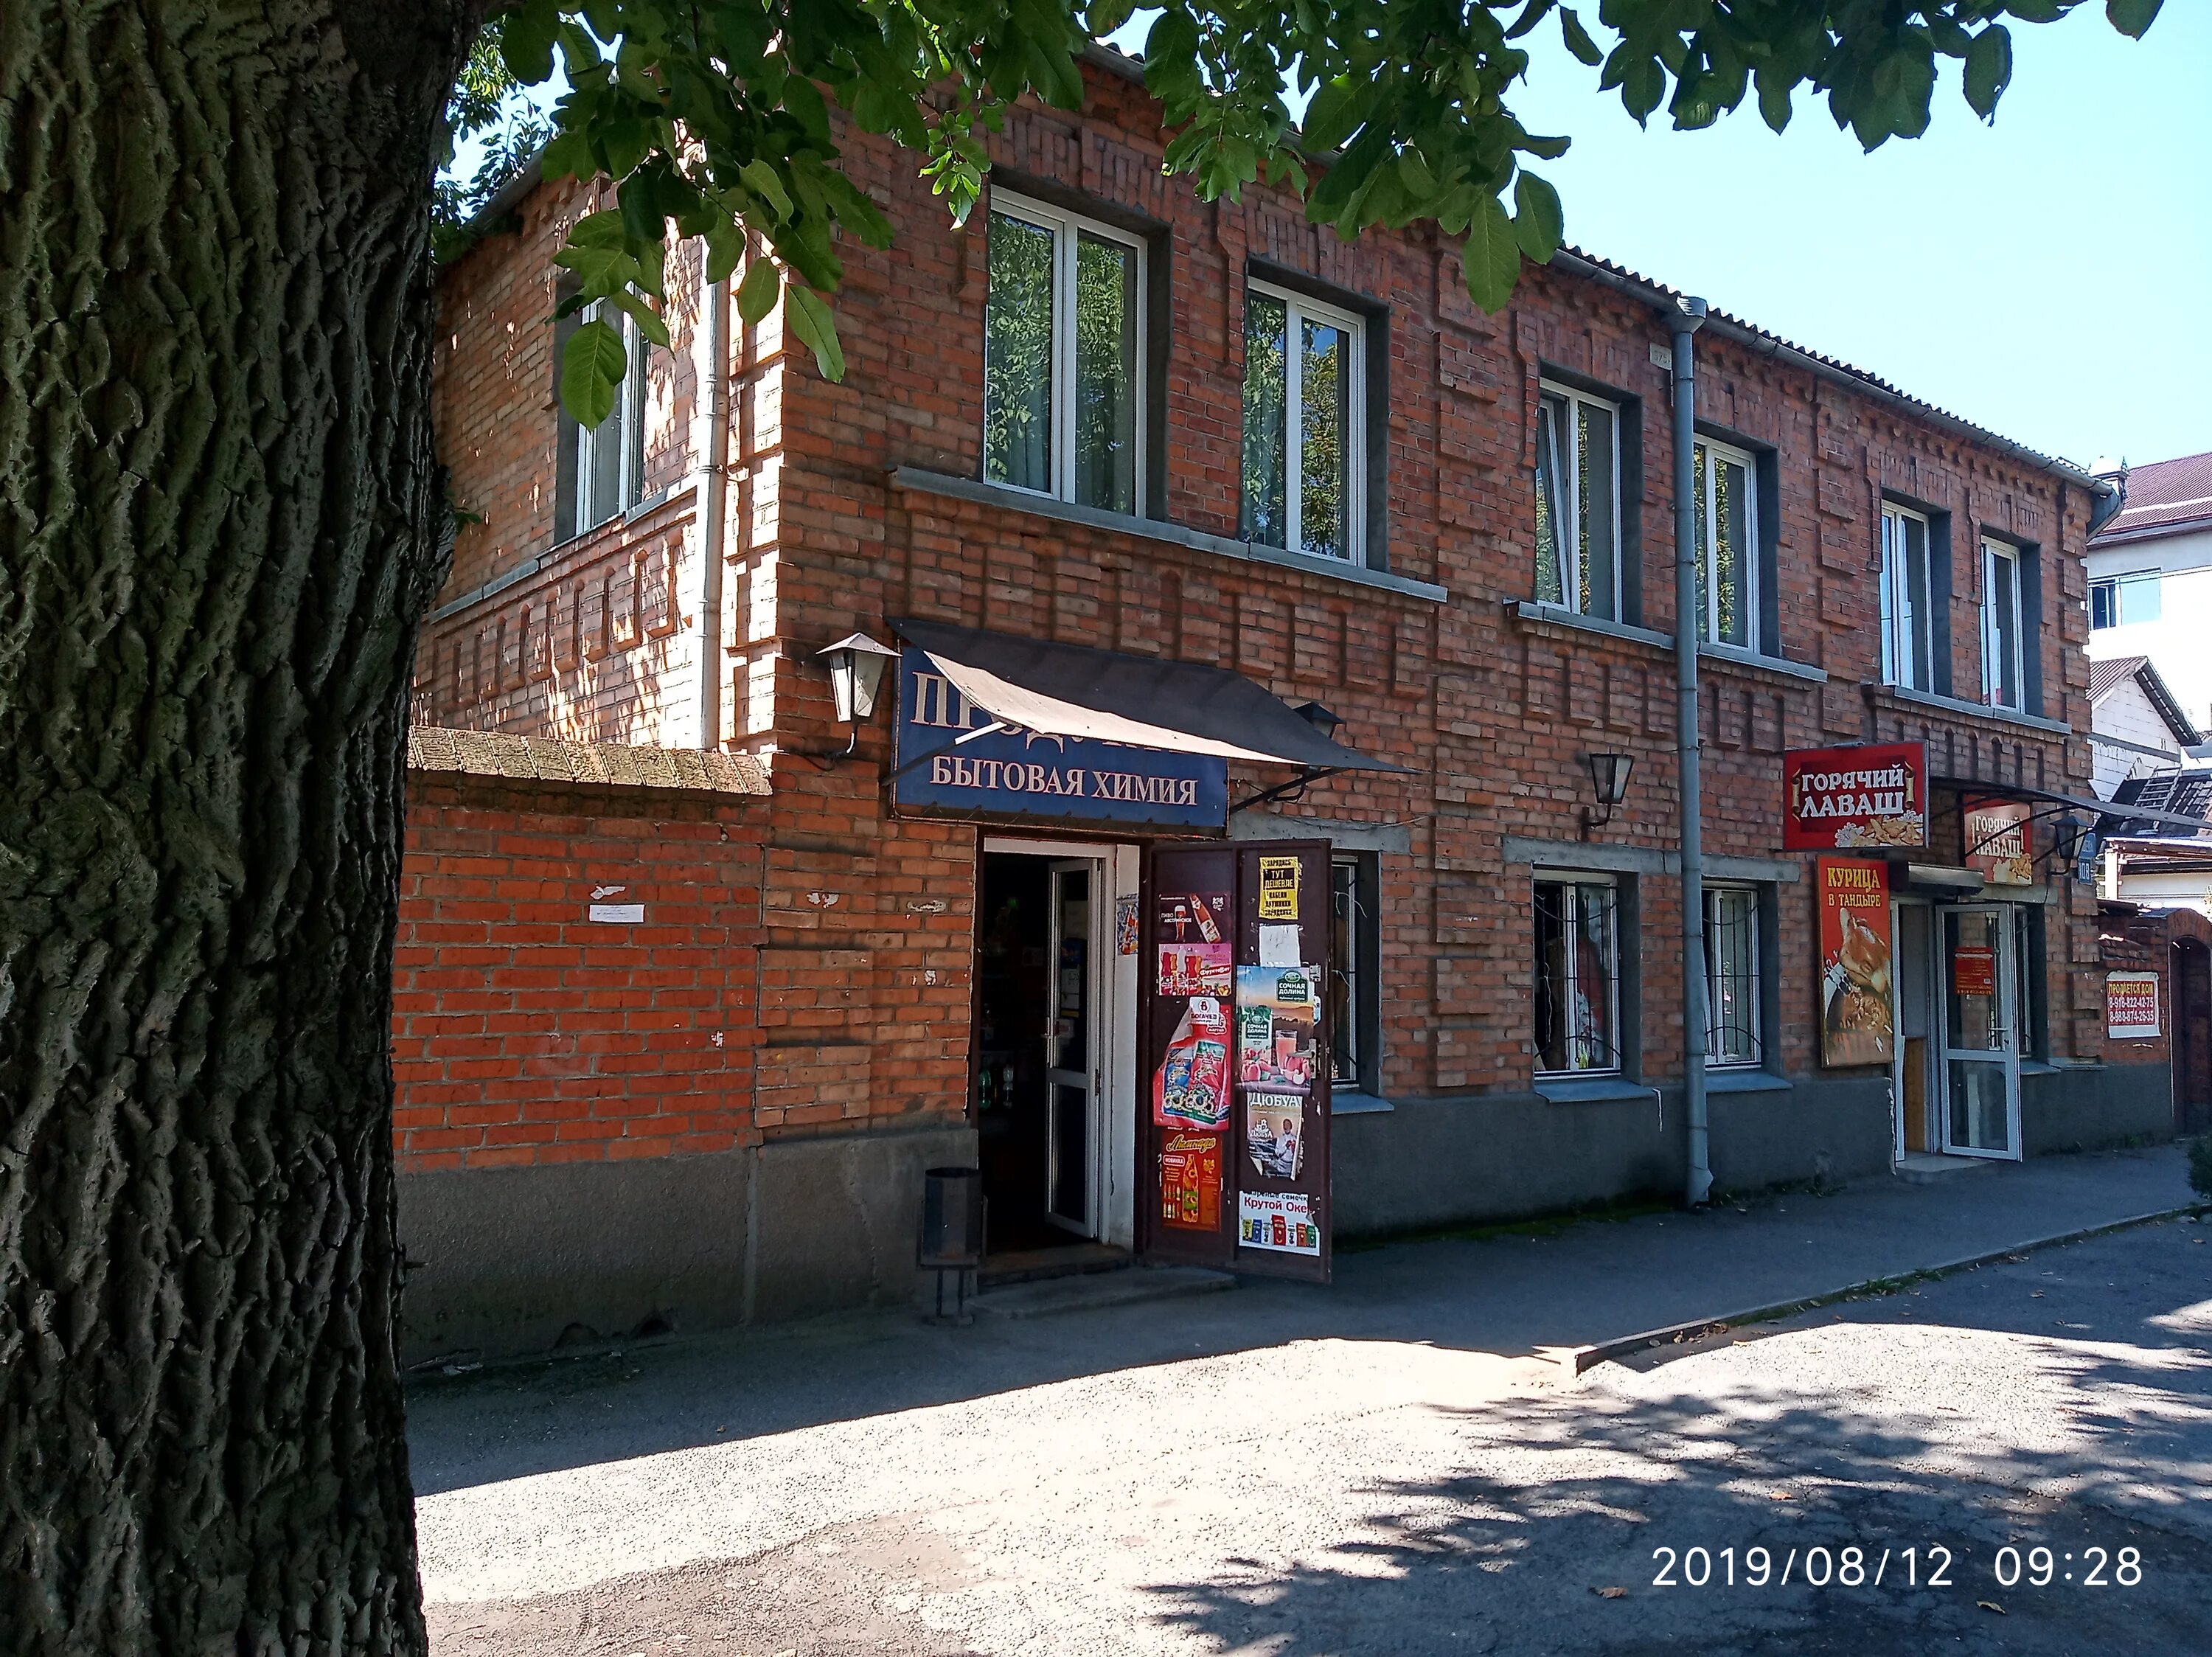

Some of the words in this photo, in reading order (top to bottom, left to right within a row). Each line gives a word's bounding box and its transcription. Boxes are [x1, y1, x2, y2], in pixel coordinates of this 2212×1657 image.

[930, 754, 1085, 797] БЫТОВАЯ
[1092, 771, 1198, 806] ХИМИЯ
[1801, 763, 1905, 792] ГОРЯЧИЙ
[1801, 791, 1905, 818] ЛАВАШ
[1975, 815, 2020, 836] ГОРЯЧИЙ
[1975, 835, 2021, 859] ЛАВАШ
[1271, 870, 1284, 879] ТУТ
[1827, 866, 1881, 893] КУРИЦА
[1265, 879, 1293, 889] ДЕШЕВЛЕ
[1829, 894, 1835, 906] В
[1838, 894, 1881, 908] ТАНДЫРЕ
[2140, 983, 2154, 996] ДОМ
[1250, 1093, 1298, 1108] ДЮБУА
[1244, 1197, 1282, 1210] Крутой
